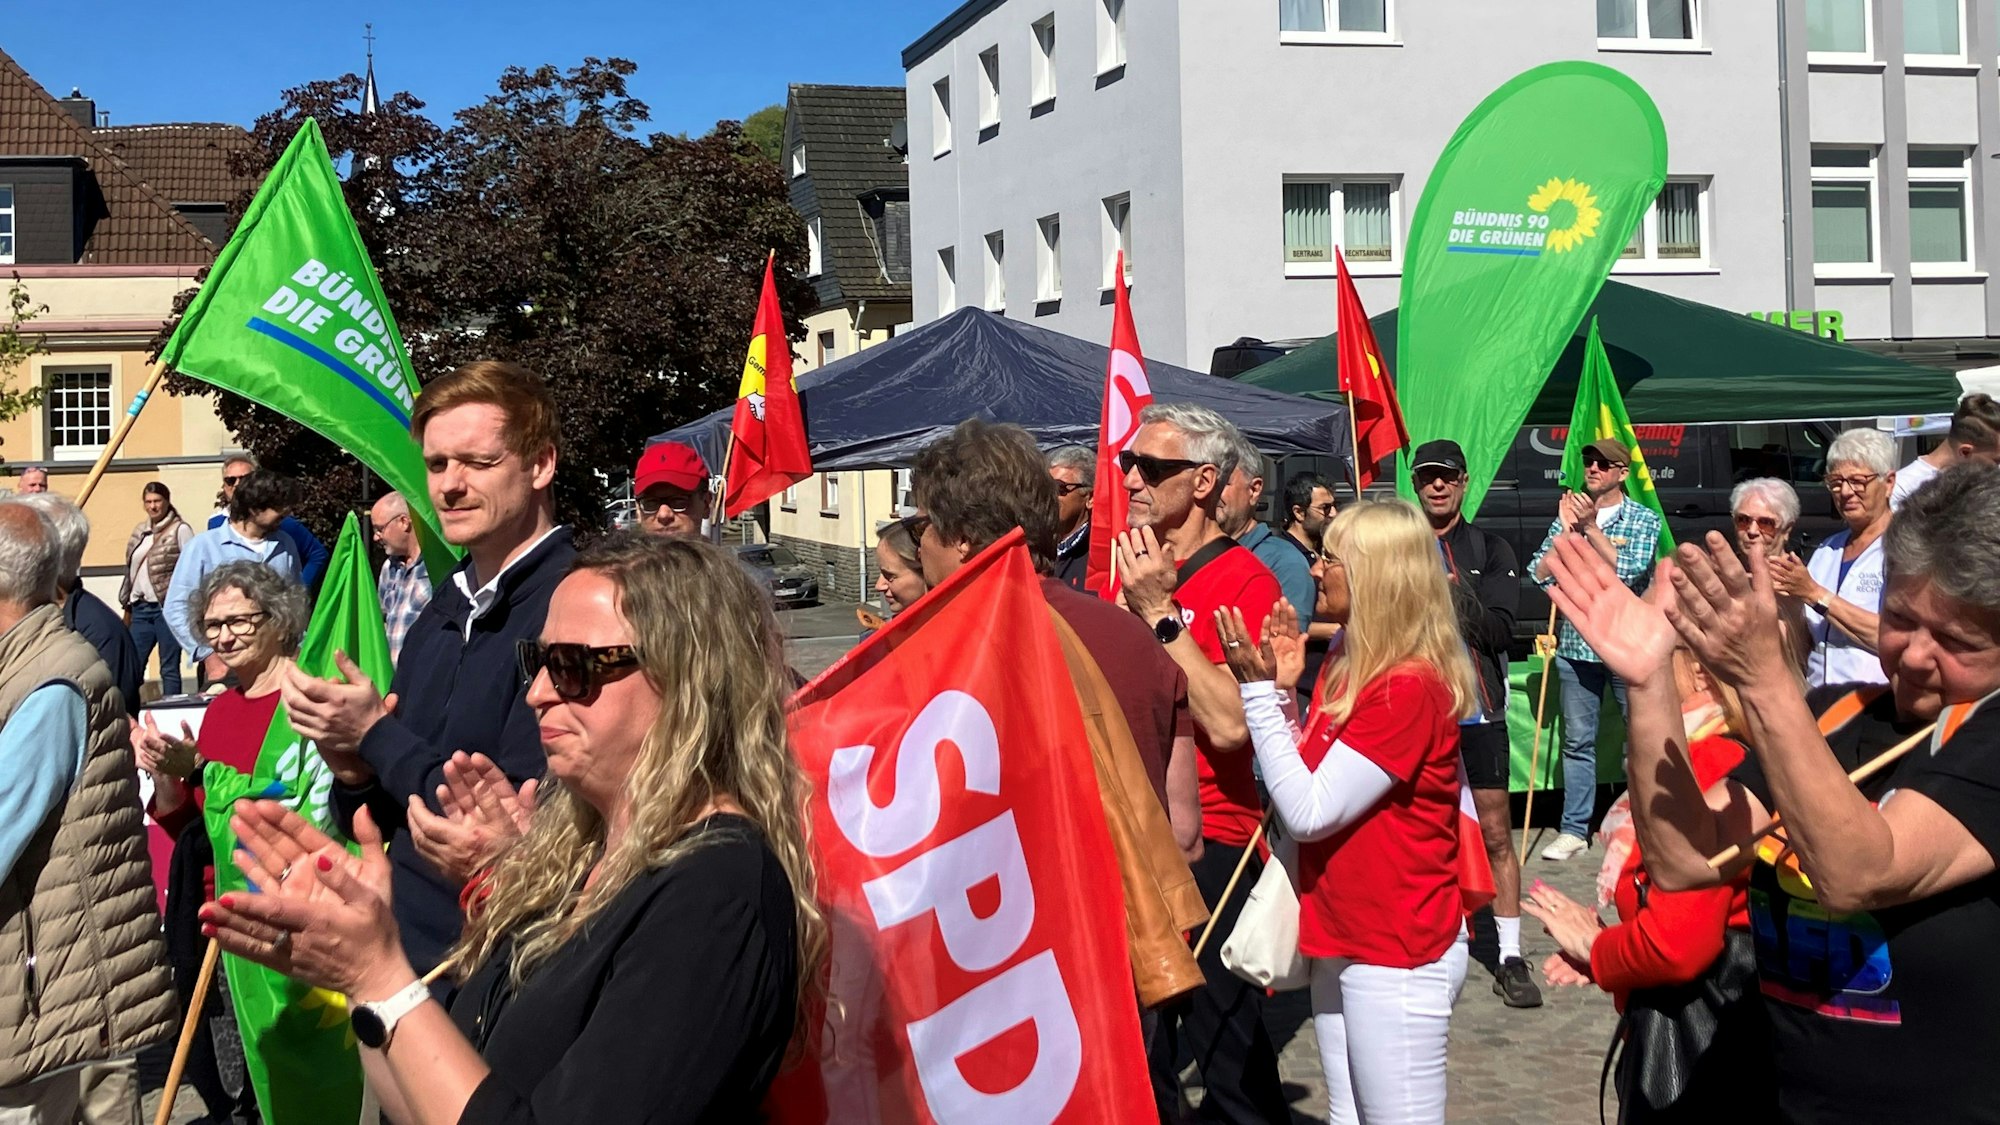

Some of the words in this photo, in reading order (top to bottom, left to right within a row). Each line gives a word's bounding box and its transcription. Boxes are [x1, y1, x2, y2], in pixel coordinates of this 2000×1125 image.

[1452, 208, 1524, 228] BÜNDNIS
[1527, 215, 1550, 229] 90
[1448, 228, 1475, 244] DIE
[1480, 227, 1546, 247] GRÜNEN
[1292, 249, 1324, 258] BERTRAMS
[261, 285, 335, 335] DIE
[748, 356, 766, 376] Gem
[828, 690, 1082, 1125] SPD
